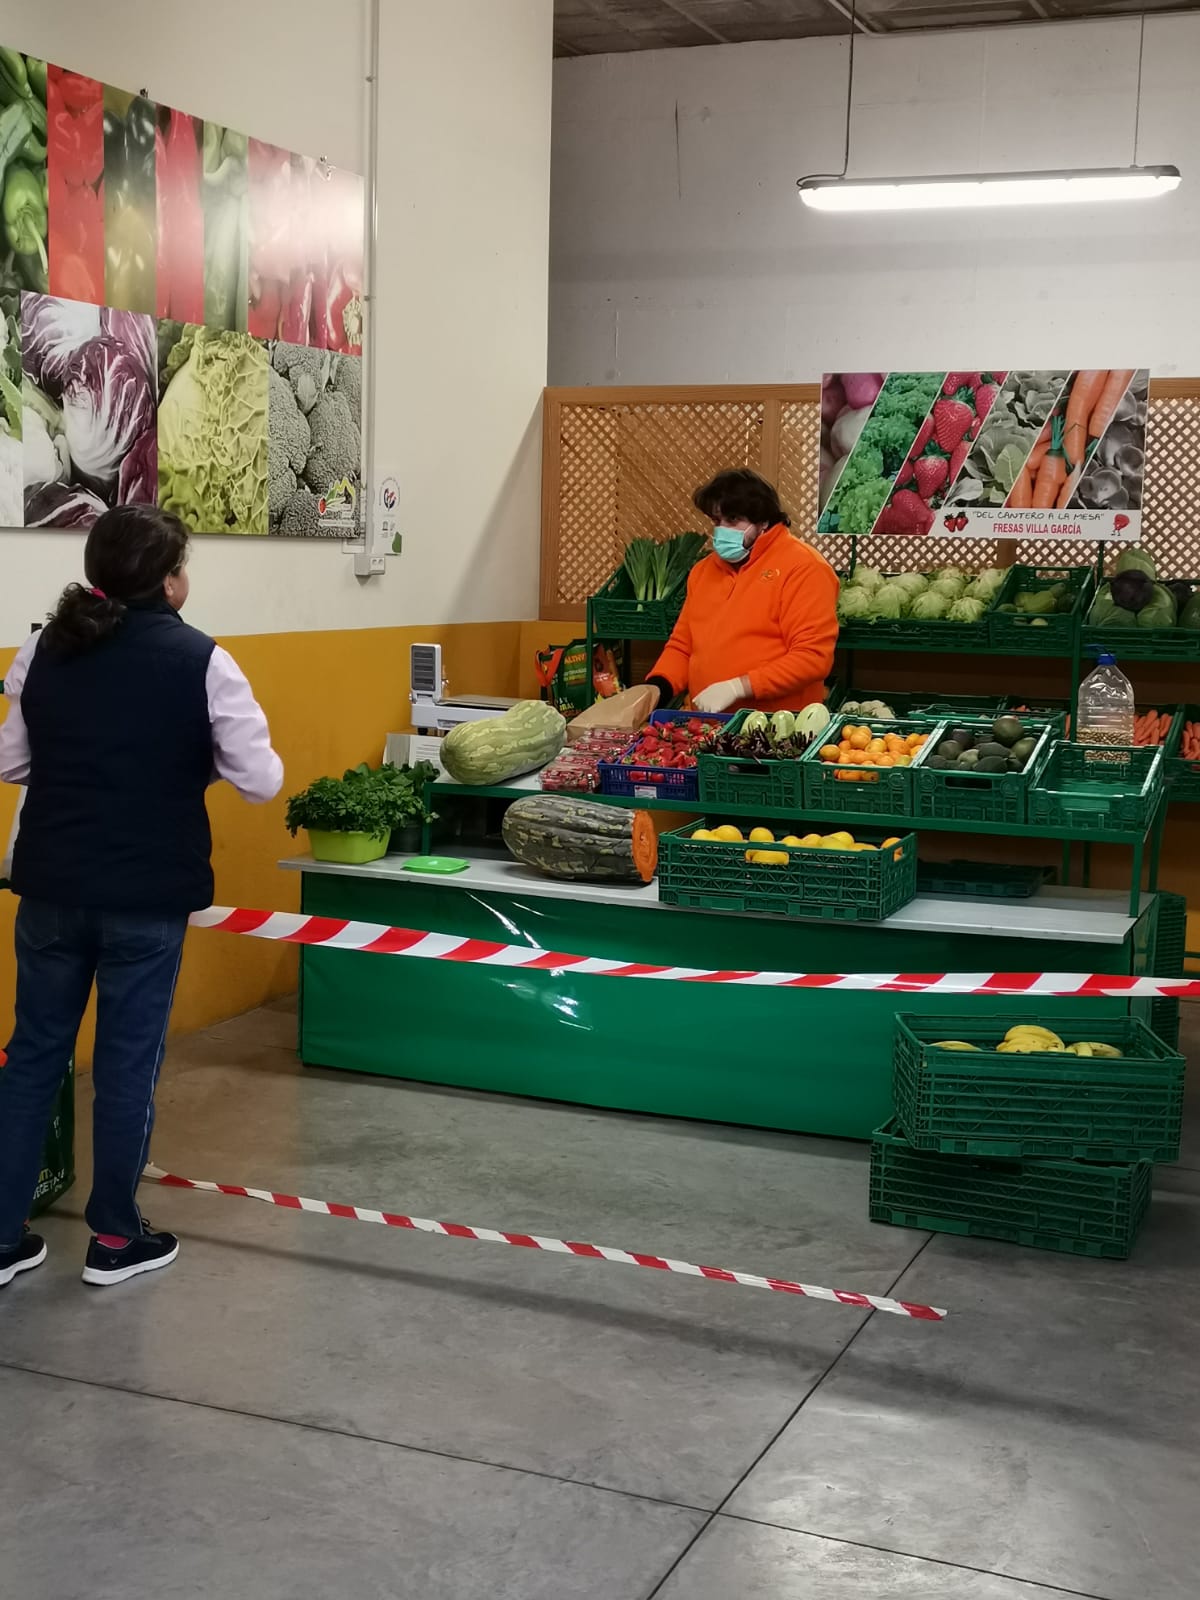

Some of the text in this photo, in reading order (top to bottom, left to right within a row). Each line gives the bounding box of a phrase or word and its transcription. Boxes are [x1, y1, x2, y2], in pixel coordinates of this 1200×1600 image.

[972, 510, 1104, 521] "DEL CANTERO A LA MESA"
[993, 522, 1082, 534] FRESAS VILLA GARCÍA
